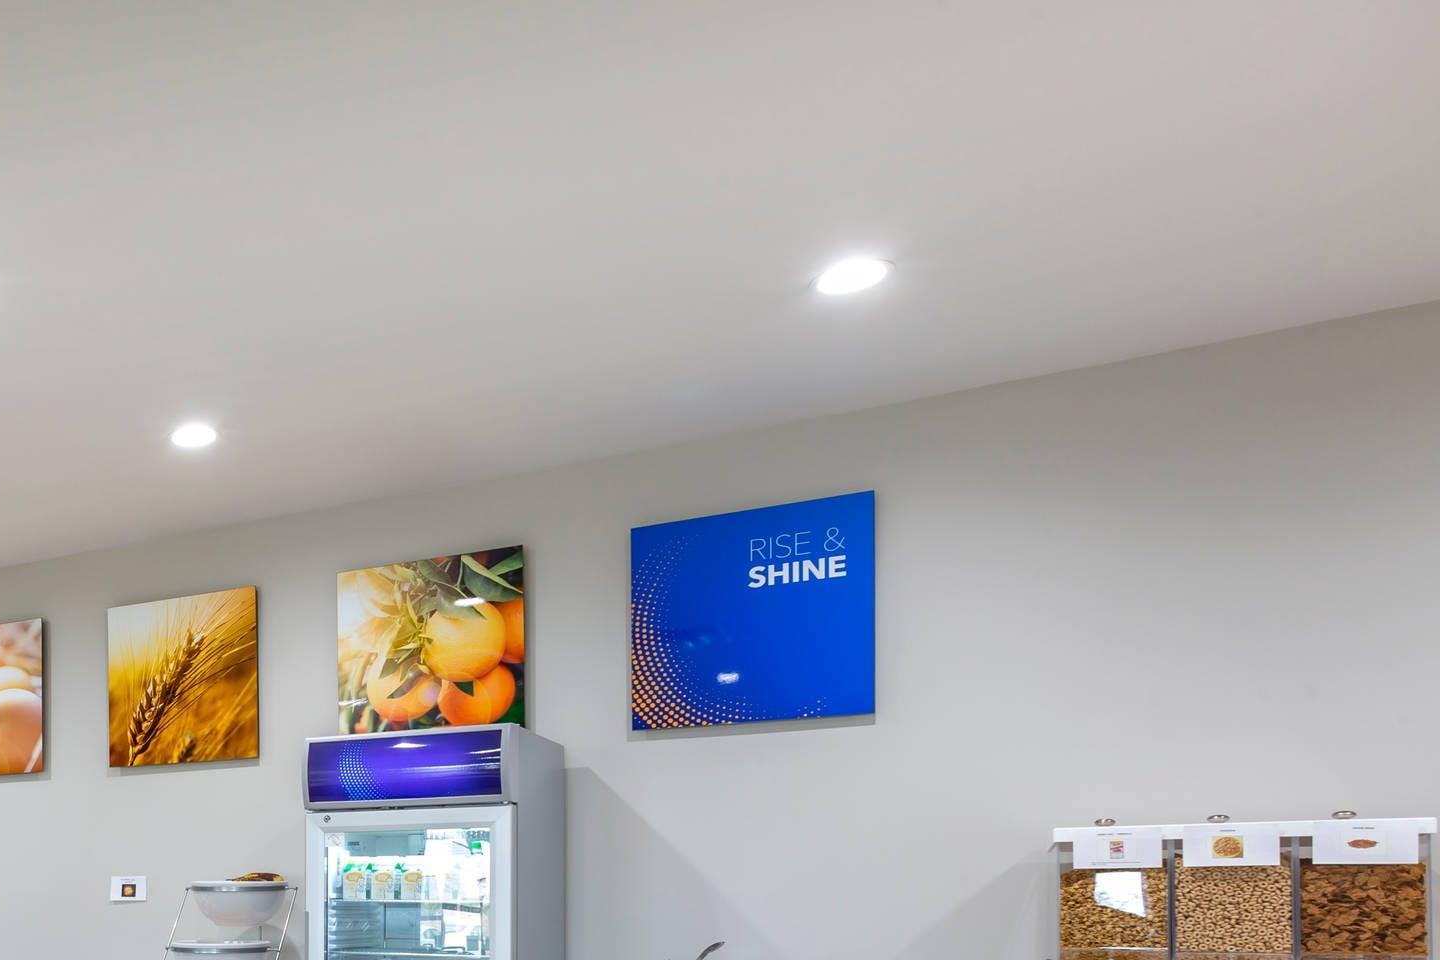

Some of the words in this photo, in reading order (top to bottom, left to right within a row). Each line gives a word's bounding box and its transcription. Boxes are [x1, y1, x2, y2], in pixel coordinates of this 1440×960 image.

[750, 531, 812, 561] RISE
[823, 527, 846, 552] &
[747, 554, 847, 588] SHINE
